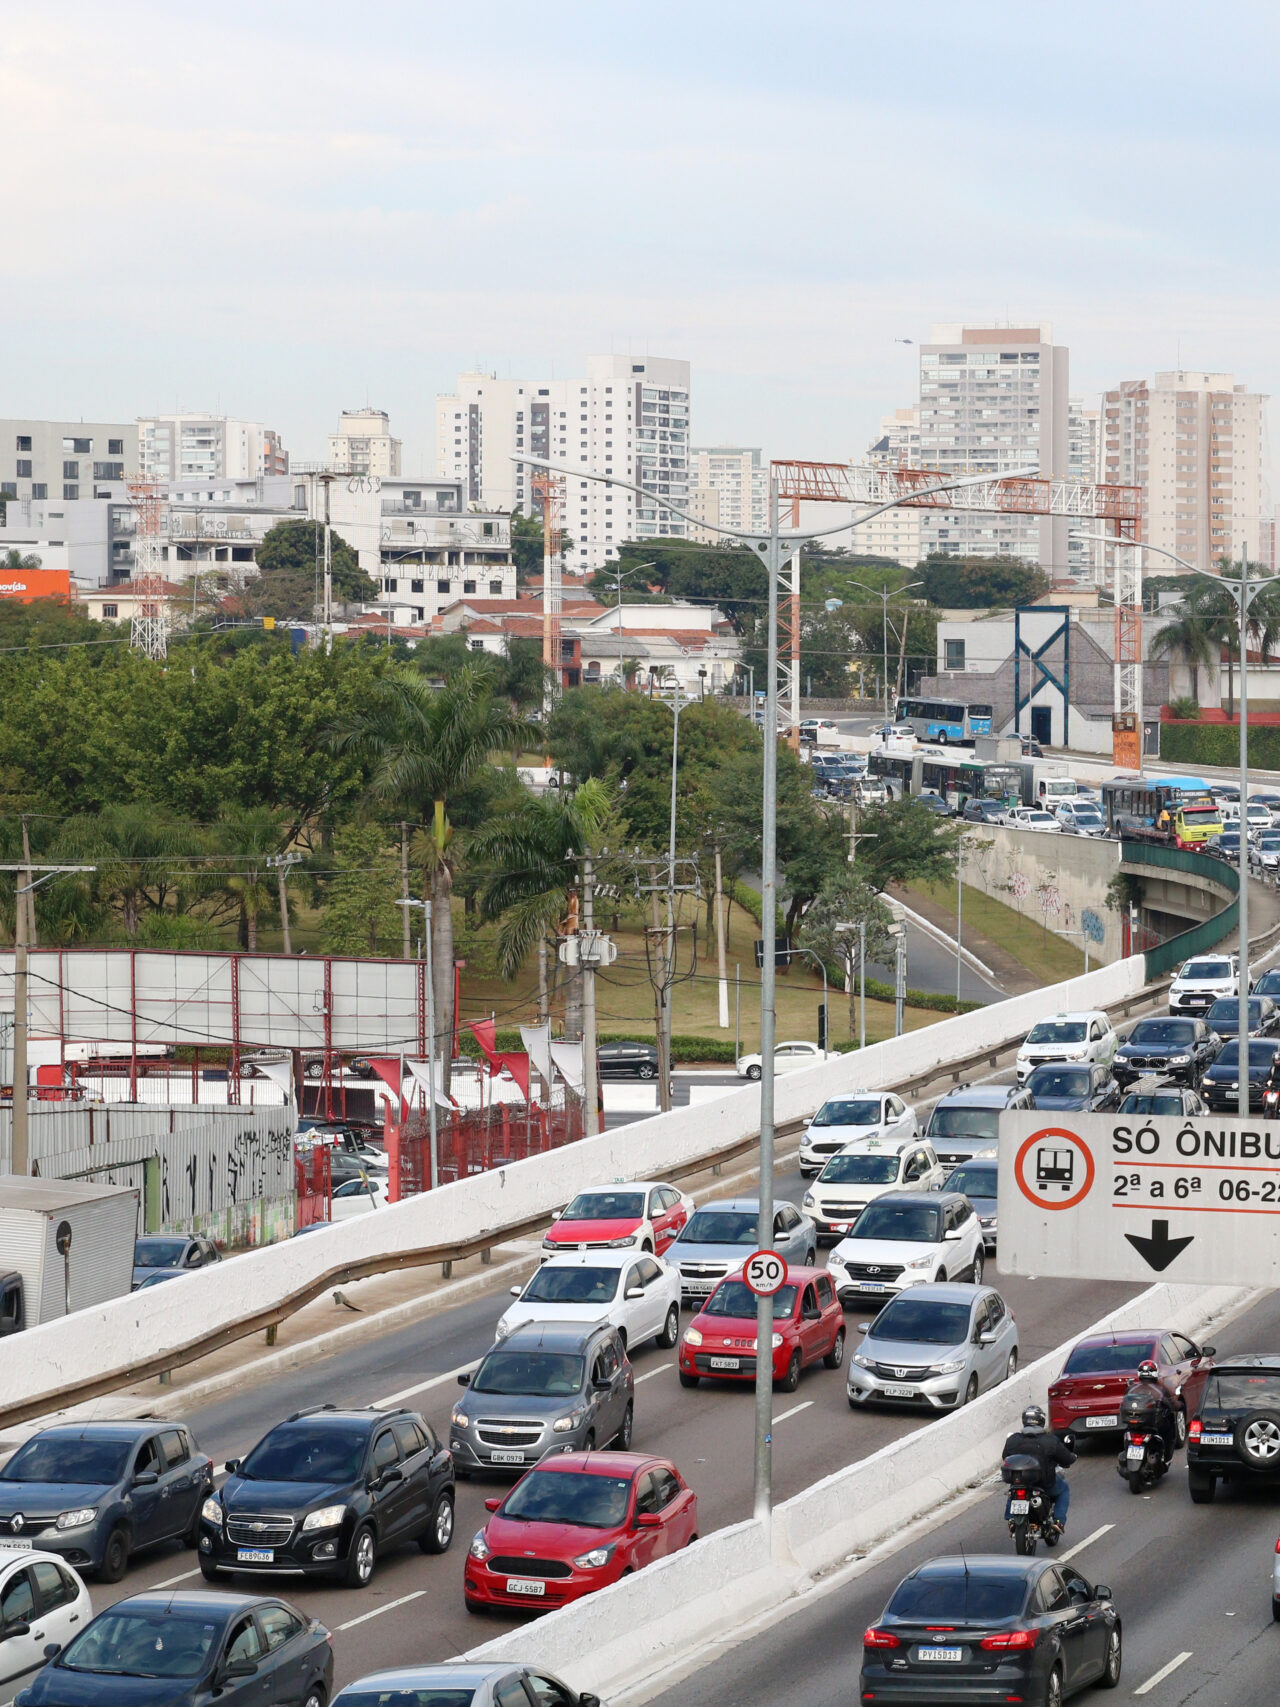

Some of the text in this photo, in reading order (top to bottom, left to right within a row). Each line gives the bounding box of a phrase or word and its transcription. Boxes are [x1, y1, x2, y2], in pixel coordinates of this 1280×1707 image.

[0, 581, 27, 592] ovida
[1112, 1119, 1160, 1155] SÓ
[1149, 1180, 1165, 1198] a
[751, 1261, 780, 1280] 50
